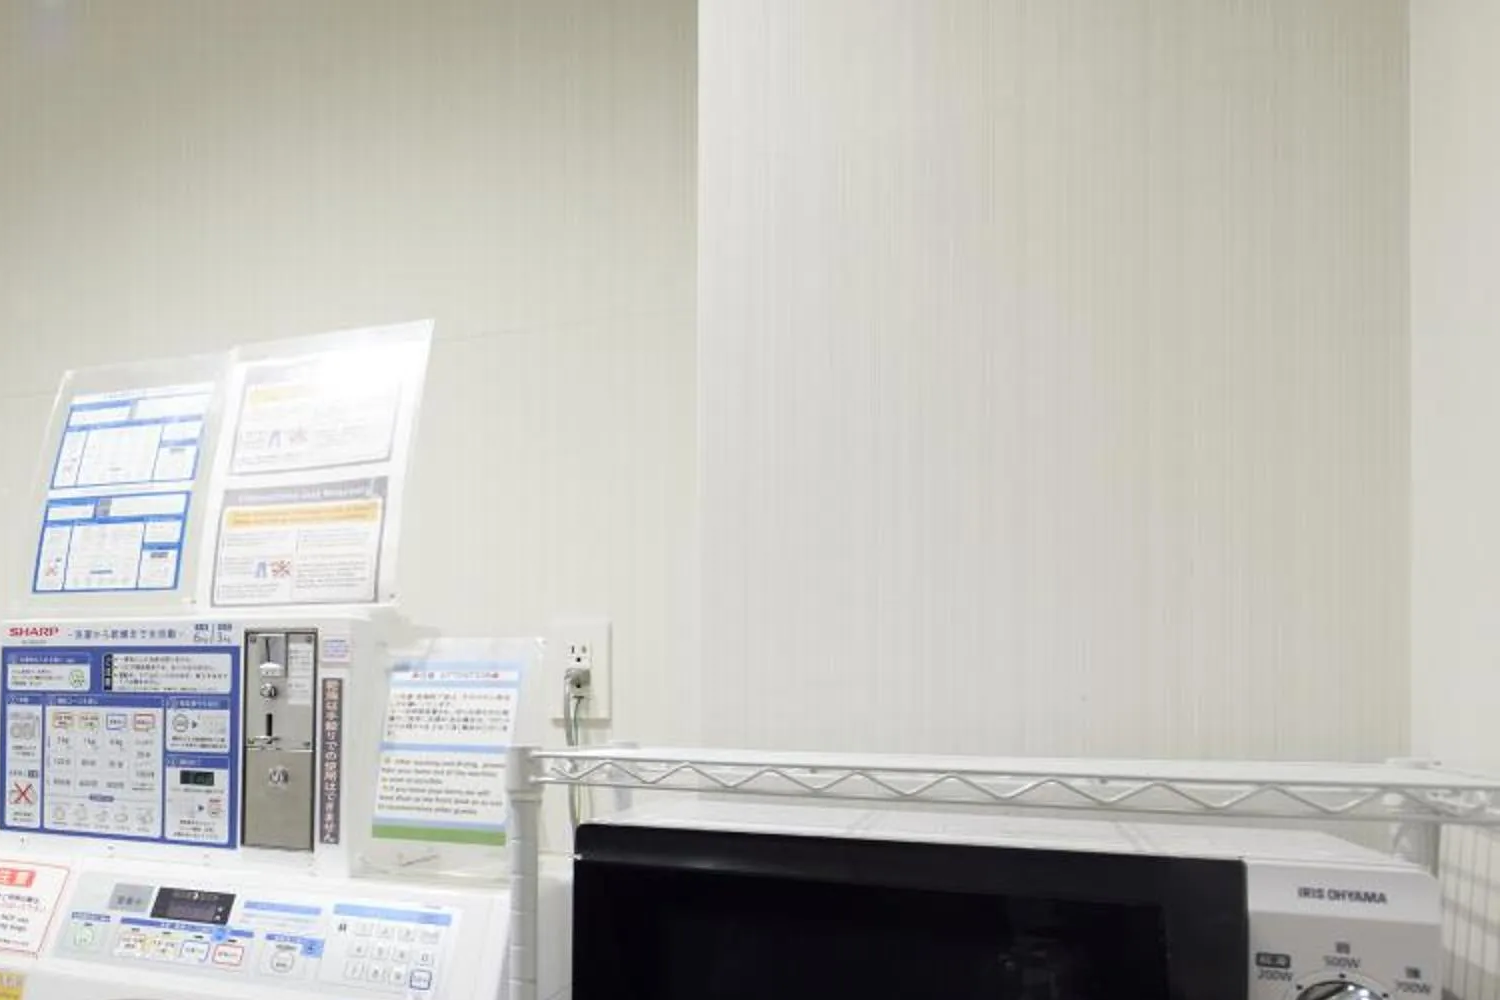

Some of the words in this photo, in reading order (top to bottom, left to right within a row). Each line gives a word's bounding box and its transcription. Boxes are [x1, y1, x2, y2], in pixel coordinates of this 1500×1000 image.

[9, 627, 59, 637] SHARP
[1298, 886, 1325, 899] IRIS
[1327, 888, 1388, 905] OHYAMA
